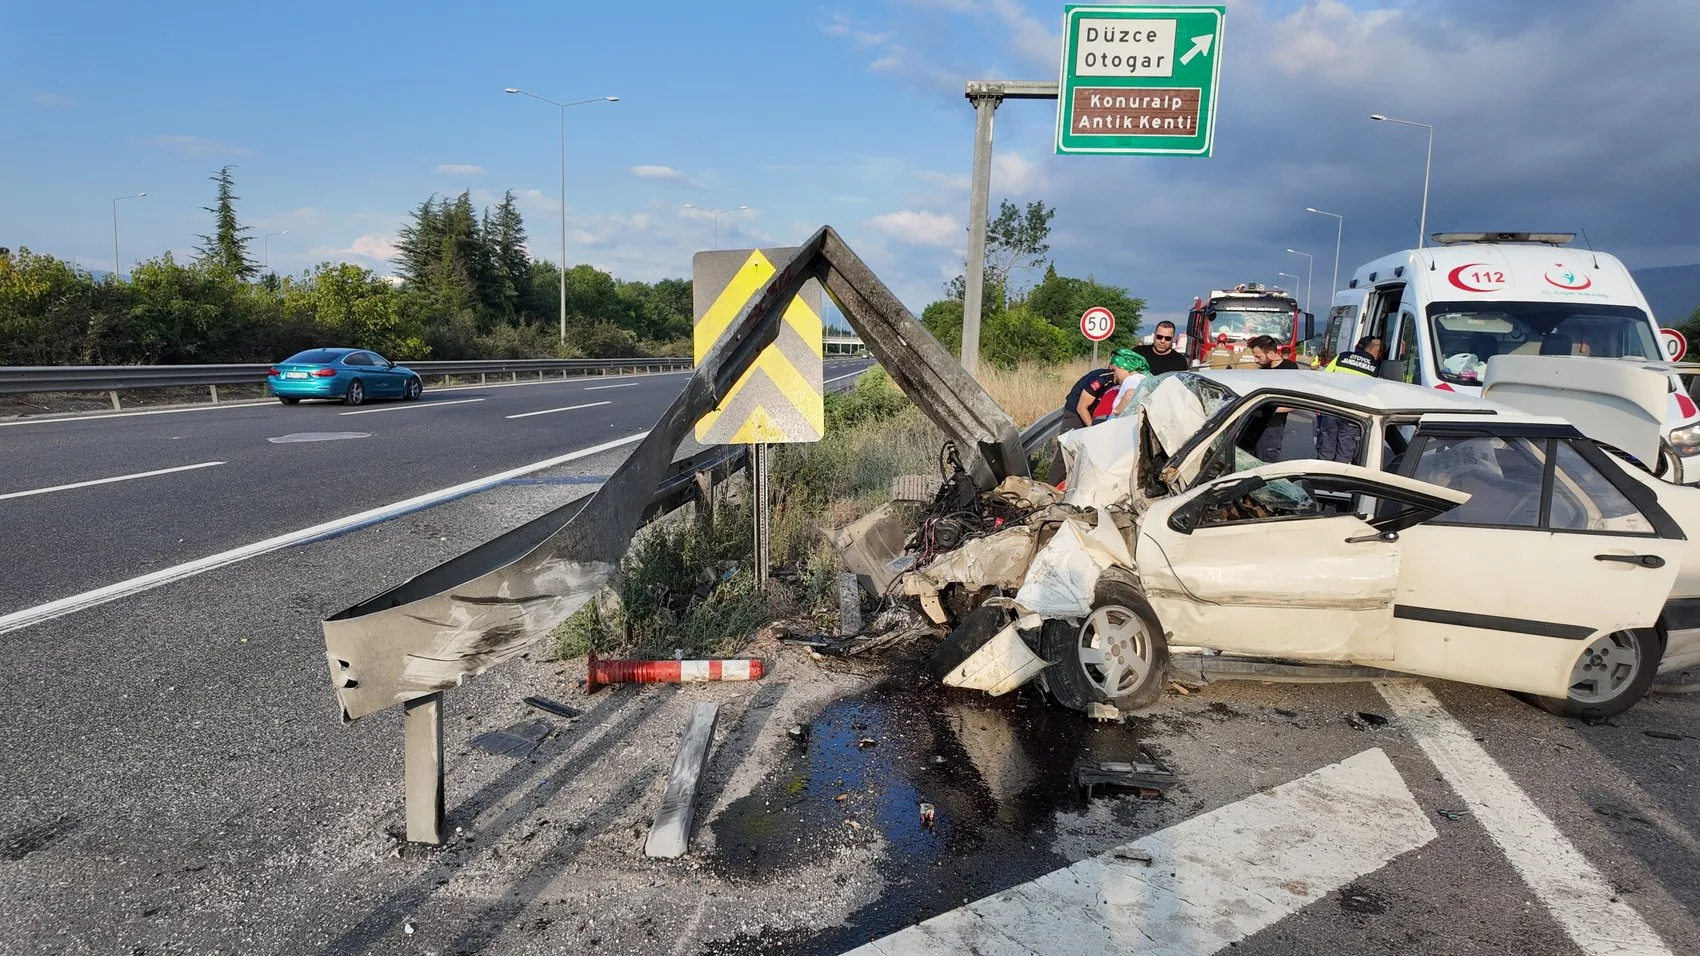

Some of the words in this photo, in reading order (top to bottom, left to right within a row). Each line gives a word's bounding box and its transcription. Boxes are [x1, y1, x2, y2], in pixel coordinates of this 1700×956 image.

[1086, 26, 1157, 43] Düzce
[1085, 52, 1165, 73] Otogar
[1090, 94, 1182, 111] Konuralp
[1078, 115, 1134, 129] Antik
[1140, 115, 1191, 130] Kenti
[1472, 271, 1505, 284] 112
[1088, 316, 1108, 331] 50
[1349, 354, 1371, 365] OTOYOL
